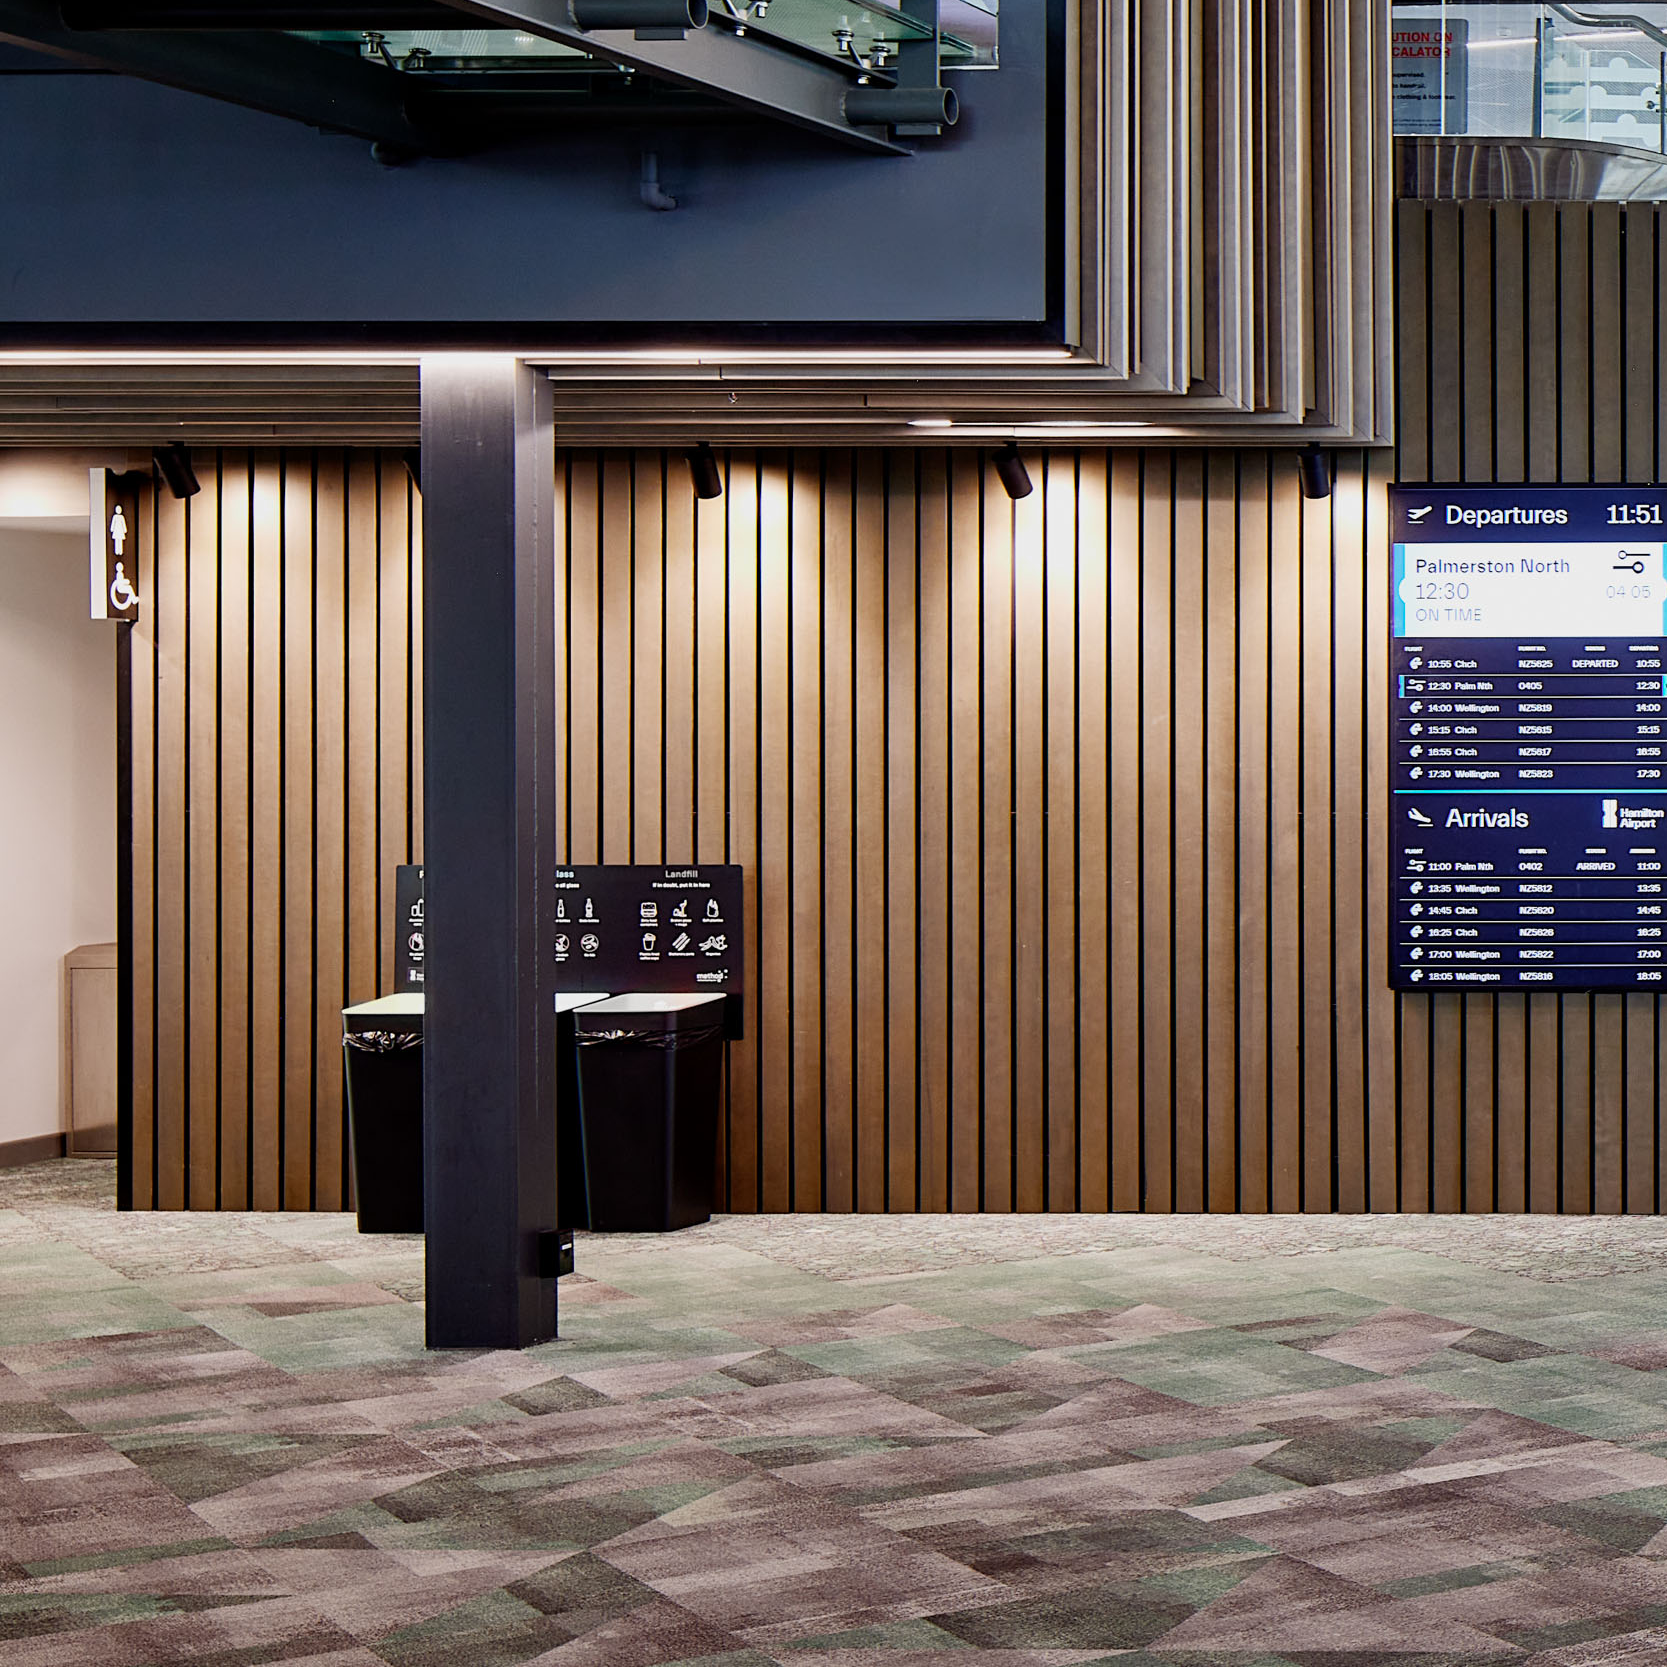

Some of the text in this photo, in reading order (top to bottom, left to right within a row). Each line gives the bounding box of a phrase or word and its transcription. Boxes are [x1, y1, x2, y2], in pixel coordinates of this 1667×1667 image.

[1392, 32, 1430, 42] UTION
[1392, 46, 1451, 57] CALATOR
[1446, 504, 1663, 528] Departures 11:51
[1416, 558, 1570, 573] Palmerston North
[1416, 582, 1469, 600] 12:30
[1416, 609, 1481, 622] ON TIME
[1427, 660, 1452, 669] 10:55
[1454, 660, 1477, 669] Chch
[1572, 660, 1618, 669] DEPARTED
[1635, 660, 1661, 669] 10:55
[1427, 682, 1451, 691] 12:30
[1454, 682, 1476, 691] Palm
[1518, 682, 1543, 691] 0405
[1636, 682, 1660, 691] 12:30
[1427, 704, 1452, 712] 14:00
[1454, 704, 1499, 714] Wellington
[1635, 704, 1661, 712] 14:00
[1427, 725, 1450, 734] 15:15
[1454, 725, 1477, 734] Chch
[1636, 725, 1660, 734] 15:15
[1454, 747, 1477, 756] Chch
[1427, 769, 1451, 778] 17:30
[1454, 769, 1500, 780] Wellington
[1636, 769, 1660, 778] 17:30
[1445, 808, 1529, 828] Arrivals
[1620, 808, 1665, 818] Hamilton
[1620, 818, 1657, 830] Airport
[1428, 862, 1452, 871] 11:00
[1455, 862, 1477, 871] Palm
[1519, 862, 1543, 871] 0402
[1576, 862, 1616, 871] ARRIVED
[1636, 862, 1661, 871] 11:00
[555, 870, 575, 878] lass
[664, 870, 699, 878] Landfill
[1428, 884, 1452, 893] 13:35
[1455, 884, 1500, 894] Wellington
[1636, 884, 1661, 893] 13:35
[1428, 906, 1452, 915] 14:45
[1455, 906, 1478, 915] Chch
[1636, 906, 1661, 915] 14:45
[1455, 928, 1478, 937] Chch
[1428, 950, 1452, 959] 17:00
[1455, 950, 1500, 960] Wellington
[1636, 950, 1661, 959] 17:00
[1455, 972, 1500, 982] Wellington
